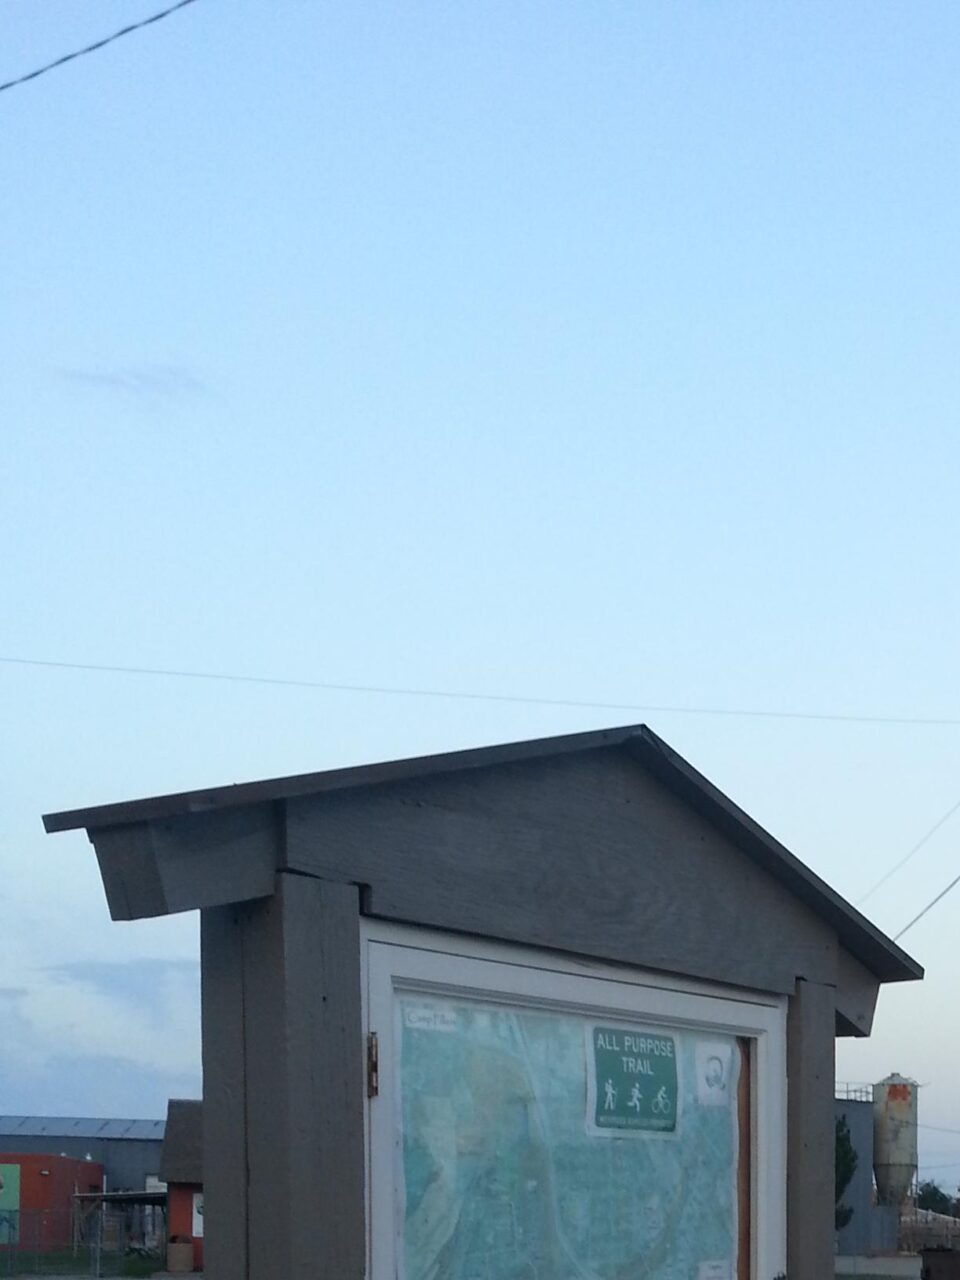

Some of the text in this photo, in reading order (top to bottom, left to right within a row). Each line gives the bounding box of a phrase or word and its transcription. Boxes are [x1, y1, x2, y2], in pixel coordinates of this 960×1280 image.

[597, 1032, 674, 1057] ALL PURPOSE
[621, 1056, 655, 1076] TRAIL
